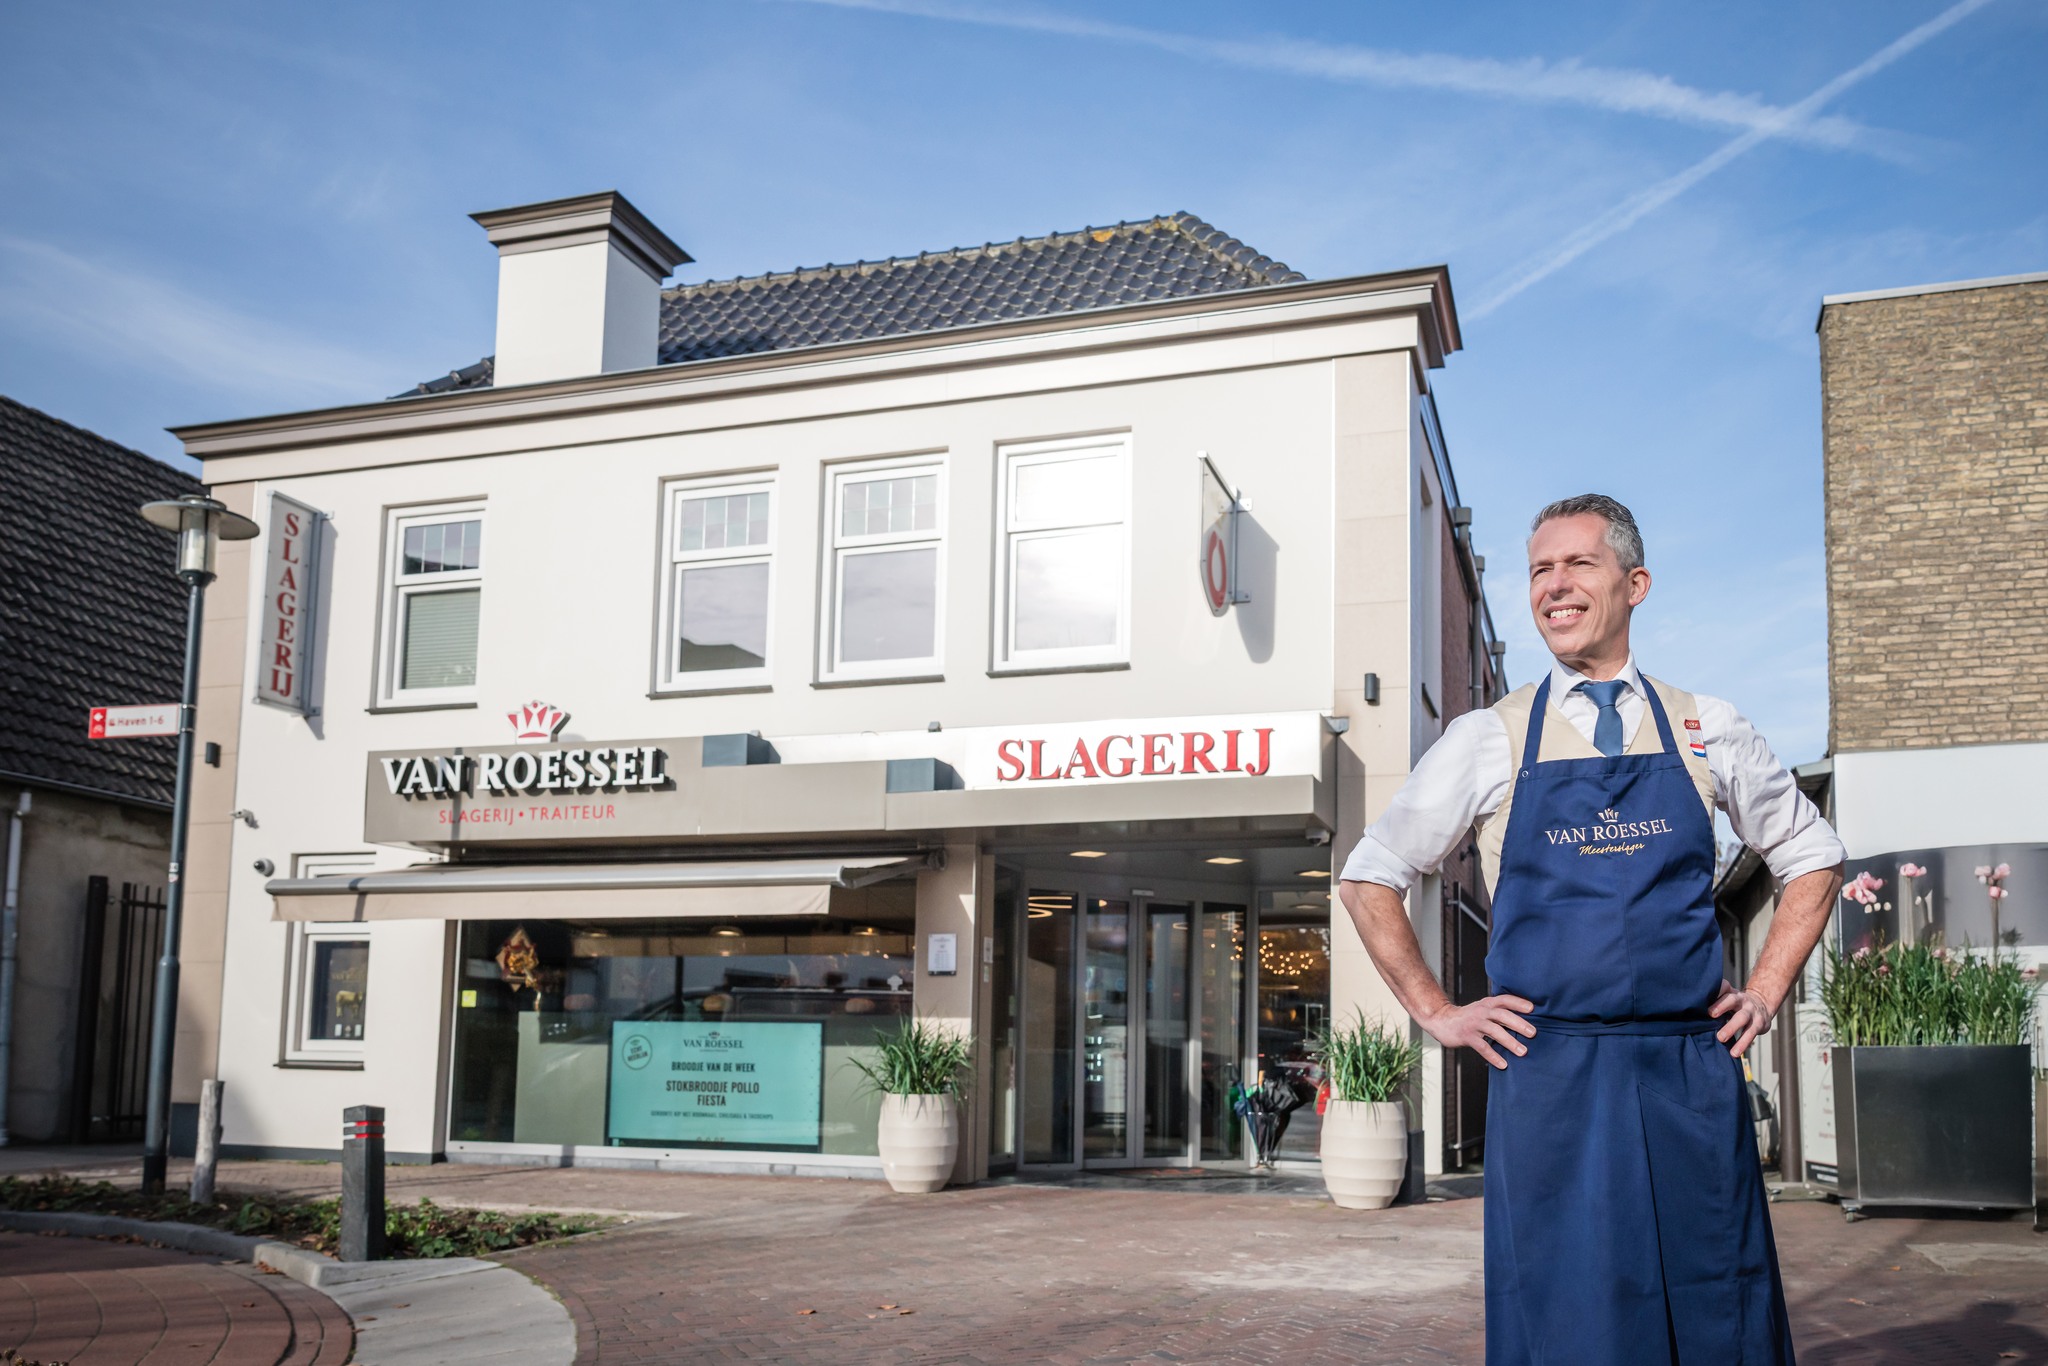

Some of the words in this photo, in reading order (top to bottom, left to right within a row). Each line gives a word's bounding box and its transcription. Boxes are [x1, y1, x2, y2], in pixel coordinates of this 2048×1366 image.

[270, 512, 299, 697] SLAGERIJ
[118, 717, 147, 726] Haven
[149, 715, 164, 725] 1-6
[996, 727, 1275, 782] SLAGERIJ
[380, 753, 468, 795] VAN
[476, 746, 666, 790] ROESSEL
[439, 808, 515, 826] SLAGERIJ
[528, 804, 616, 821] TRAITEUR
[1544, 827, 1587, 845] VAN
[1592, 818, 1673, 841] ROESSEL
[1579, 842, 1645, 856] Meesterslager
[683, 1039, 702, 1048] VAN
[704, 1039, 744, 1049] ROESSEL
[671, 1061, 704, 1072] BROODJE
[707, 1062, 722, 1072] VAN
[724, 1062, 733, 1072] DE
[735, 1063, 756, 1073] WEEK
[666, 1080, 728, 1093] STOKBROODJE
[731, 1081, 760, 1094] POLLO
[697, 1094, 726, 1106] FIESTA
